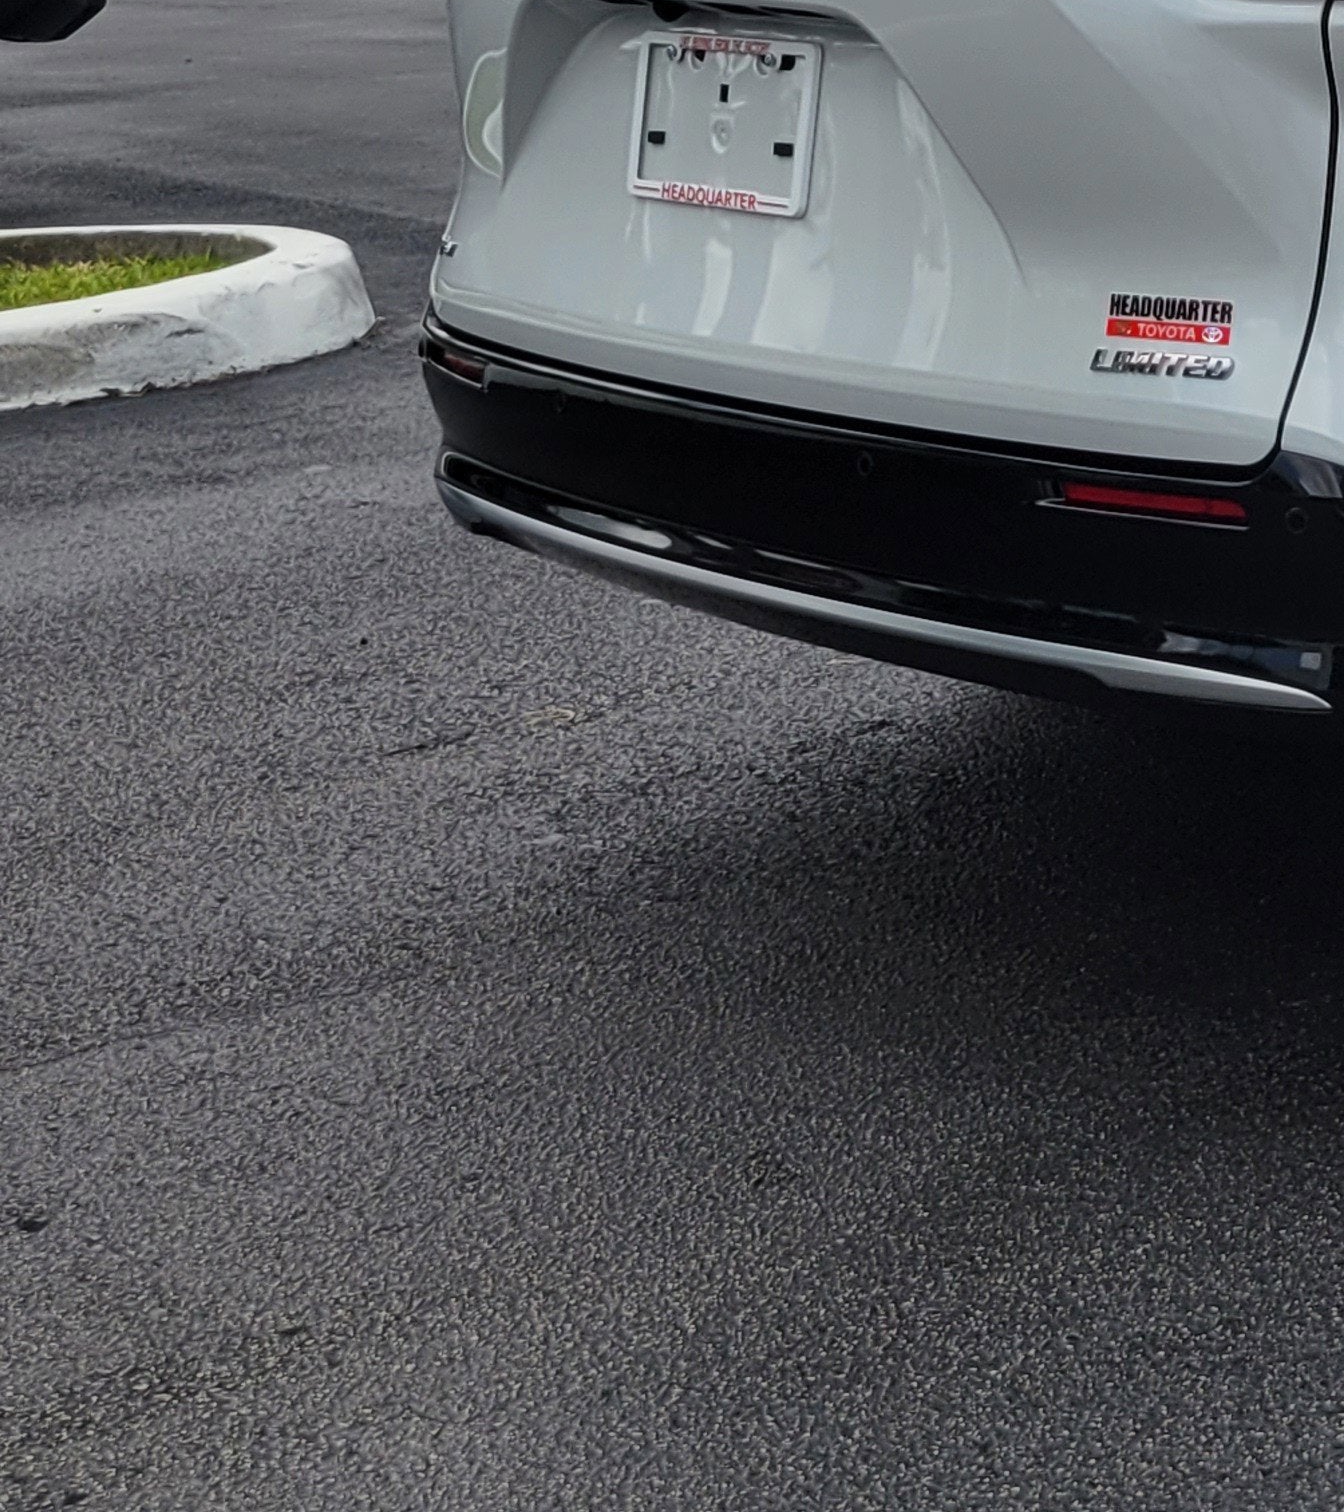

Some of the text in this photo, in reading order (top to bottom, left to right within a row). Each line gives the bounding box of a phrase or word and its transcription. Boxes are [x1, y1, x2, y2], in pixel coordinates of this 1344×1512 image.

[661, 182, 758, 210] HEADQUARTER
[1109, 293, 1234, 324] HEADQUARTER
[1137, 323, 1196, 340] TOYOTA
[1090, 349, 1236, 381] LIMITED
